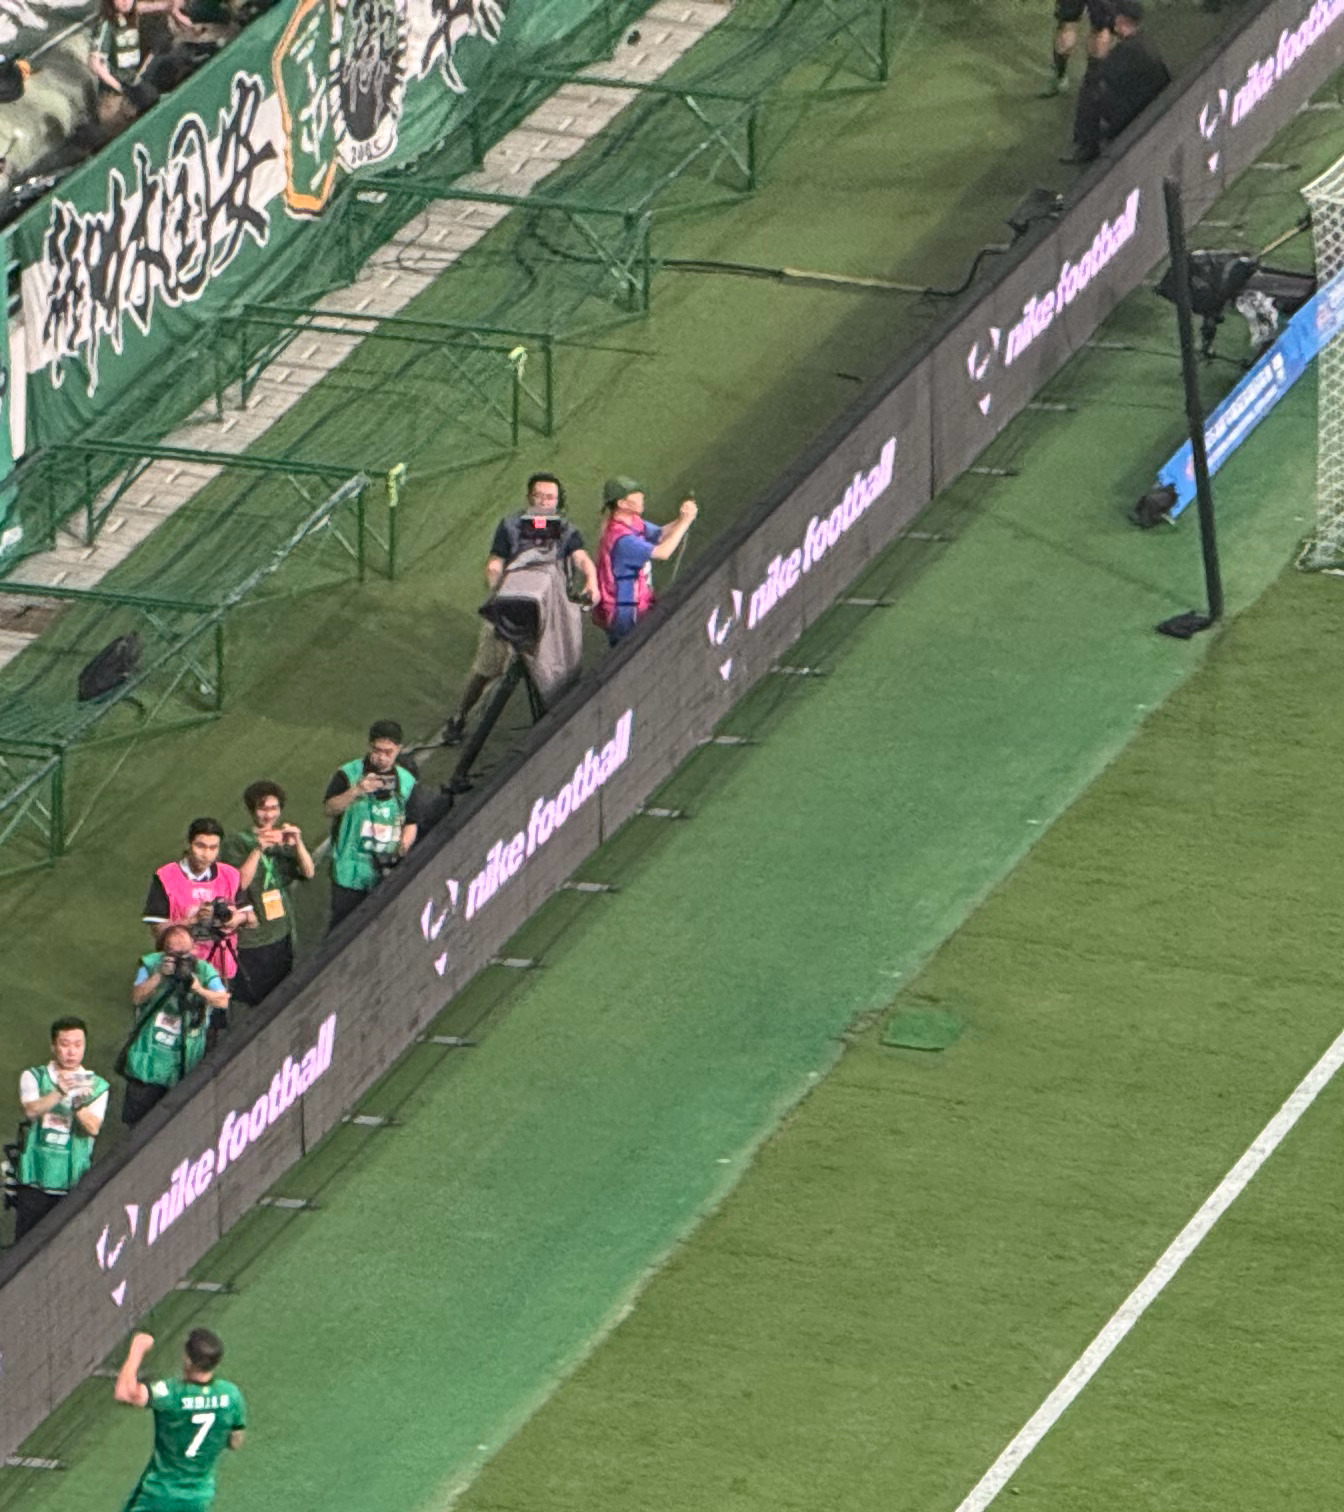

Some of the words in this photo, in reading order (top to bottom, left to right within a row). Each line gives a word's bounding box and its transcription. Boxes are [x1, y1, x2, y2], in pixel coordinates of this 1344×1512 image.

[1232, 55, 1274, 126] nike
[1005, 290, 1055, 366] nike
[1056, 186, 1139, 314] football
[747, 546, 801, 630] nike
[802, 435, 896, 574] football
[465, 831, 526, 920] nike
[525, 706, 633, 858] football
[147, 1148, 216, 1246] nike
[216, 1011, 336, 1177] football
[185, 1411, 216, 1459] 7
